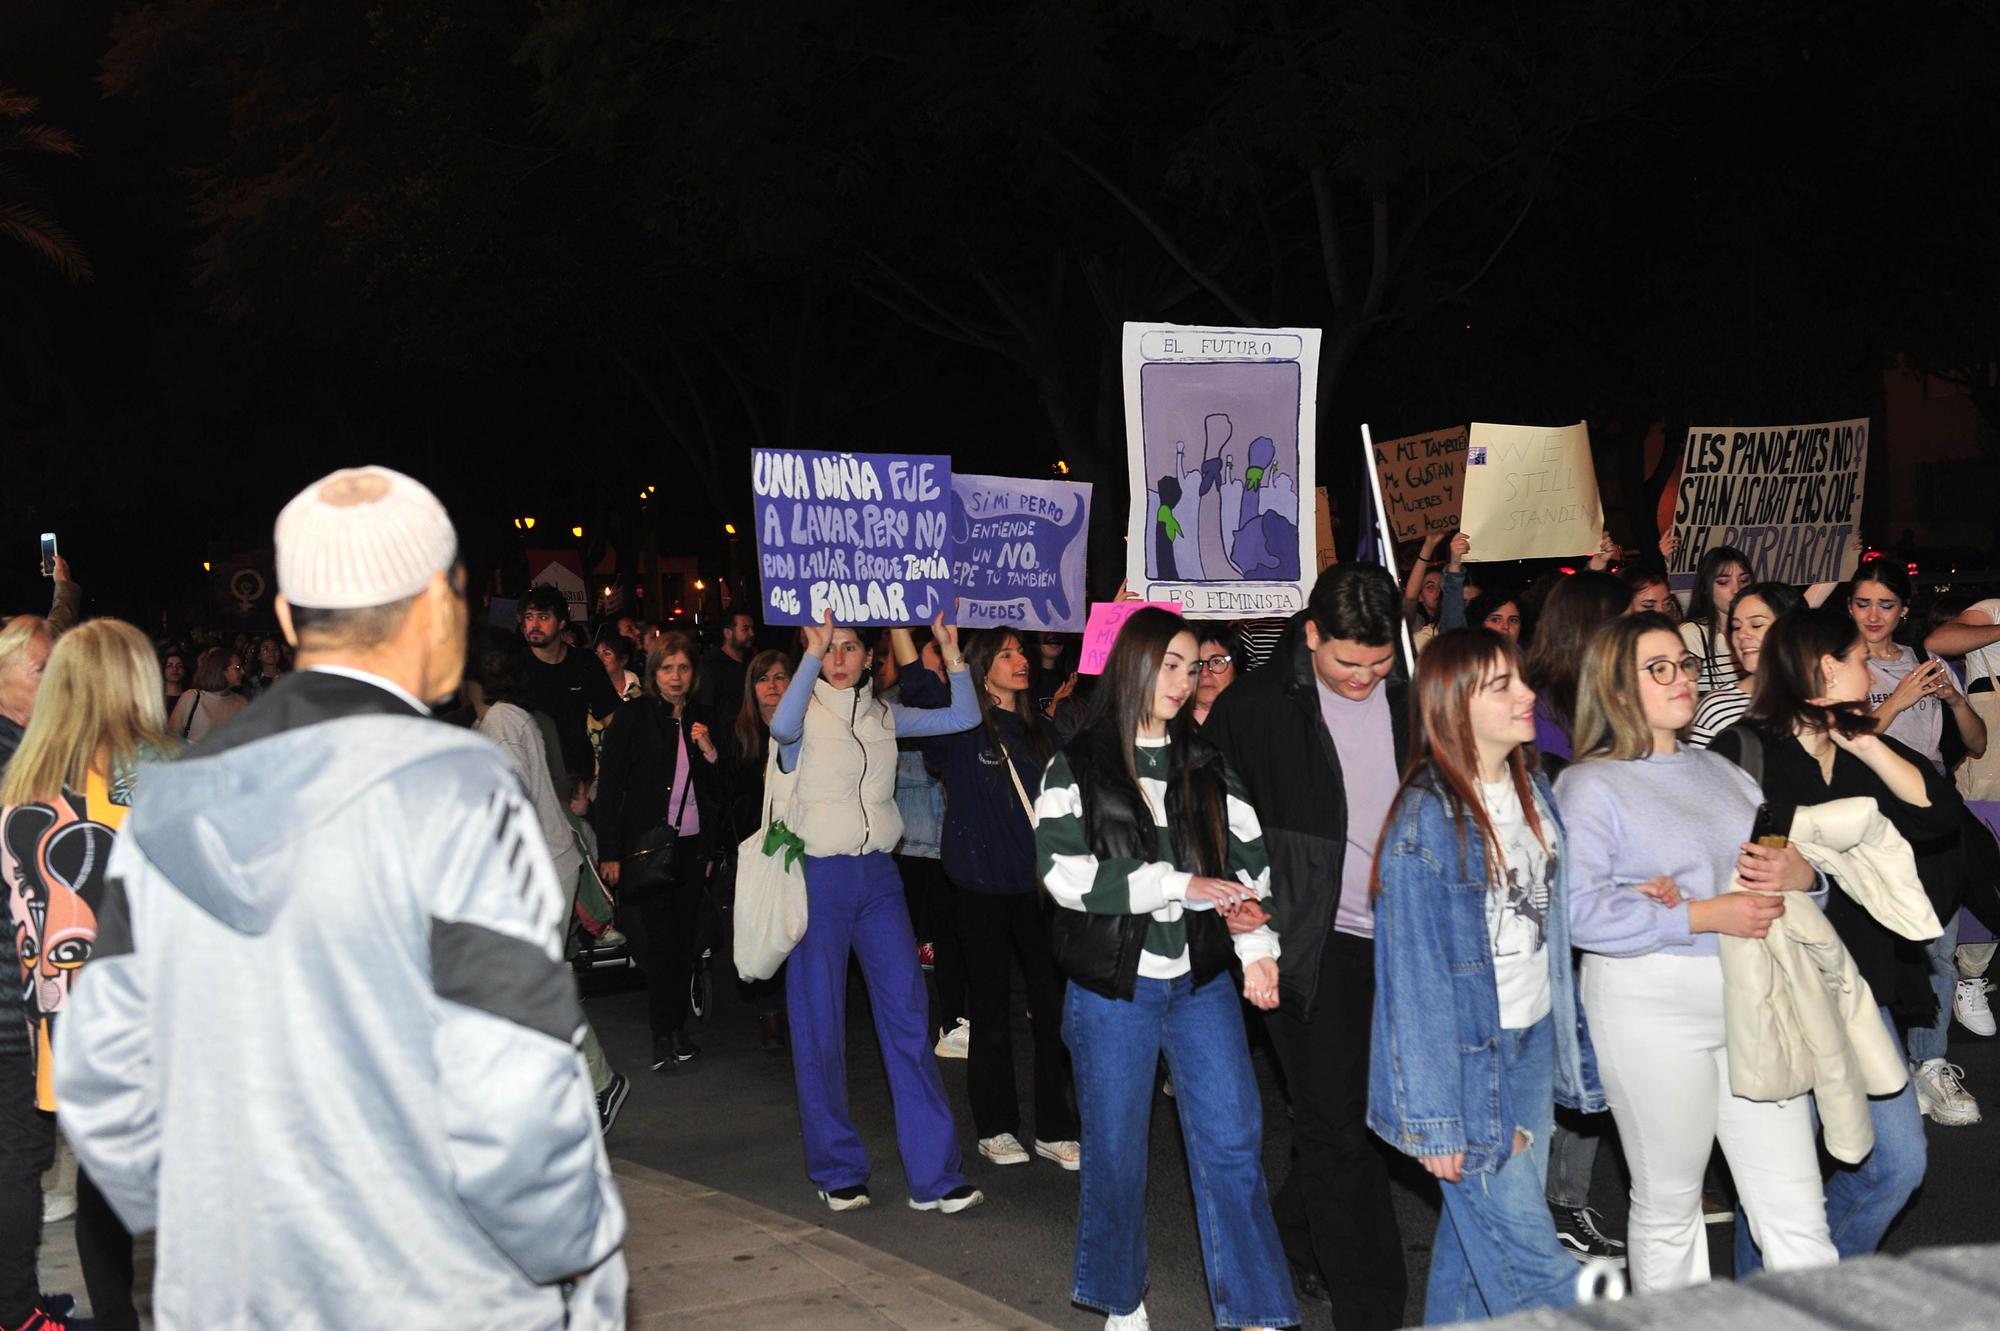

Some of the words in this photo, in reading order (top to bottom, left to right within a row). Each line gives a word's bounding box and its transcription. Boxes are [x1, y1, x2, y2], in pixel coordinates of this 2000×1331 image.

[1164, 339, 1184, 354] EL
[1201, 338, 1272, 355] FUTURO
[1376, 447, 1388, 466] A
[1488, 433, 1563, 463] WE
[1685, 433, 1726, 474] LES
[1830, 426, 1853, 472] NO
[754, 452, 811, 500] UNA
[888, 461, 941, 502] FUE
[1406, 461, 1454, 488] GUSTAN
[1504, 467, 1577, 503] STILL
[1443, 485, 1453, 502] Y
[1676, 475, 1736, 526] S'HAN
[1731, 475, 1799, 526] ACABAT
[1791, 474, 1827, 525] ENS
[1020, 494, 1063, 523] PERRO
[763, 503, 785, 547] A
[862, 504, 909, 549] PERO
[915, 510, 947, 550] NO
[763, 553, 795, 580] PUDO
[800, 547, 850, 580] LAVAR
[854, 550, 903, 583] PORQUE
[972, 547, 992, 564] UN
[770, 585, 800, 616] QUE
[810, 580, 910, 624] BAILAR
[969, 603, 1025, 620] PUEDES
[1169, 589, 1195, 608] ES
[1206, 591, 1294, 610] FEMINISTA
